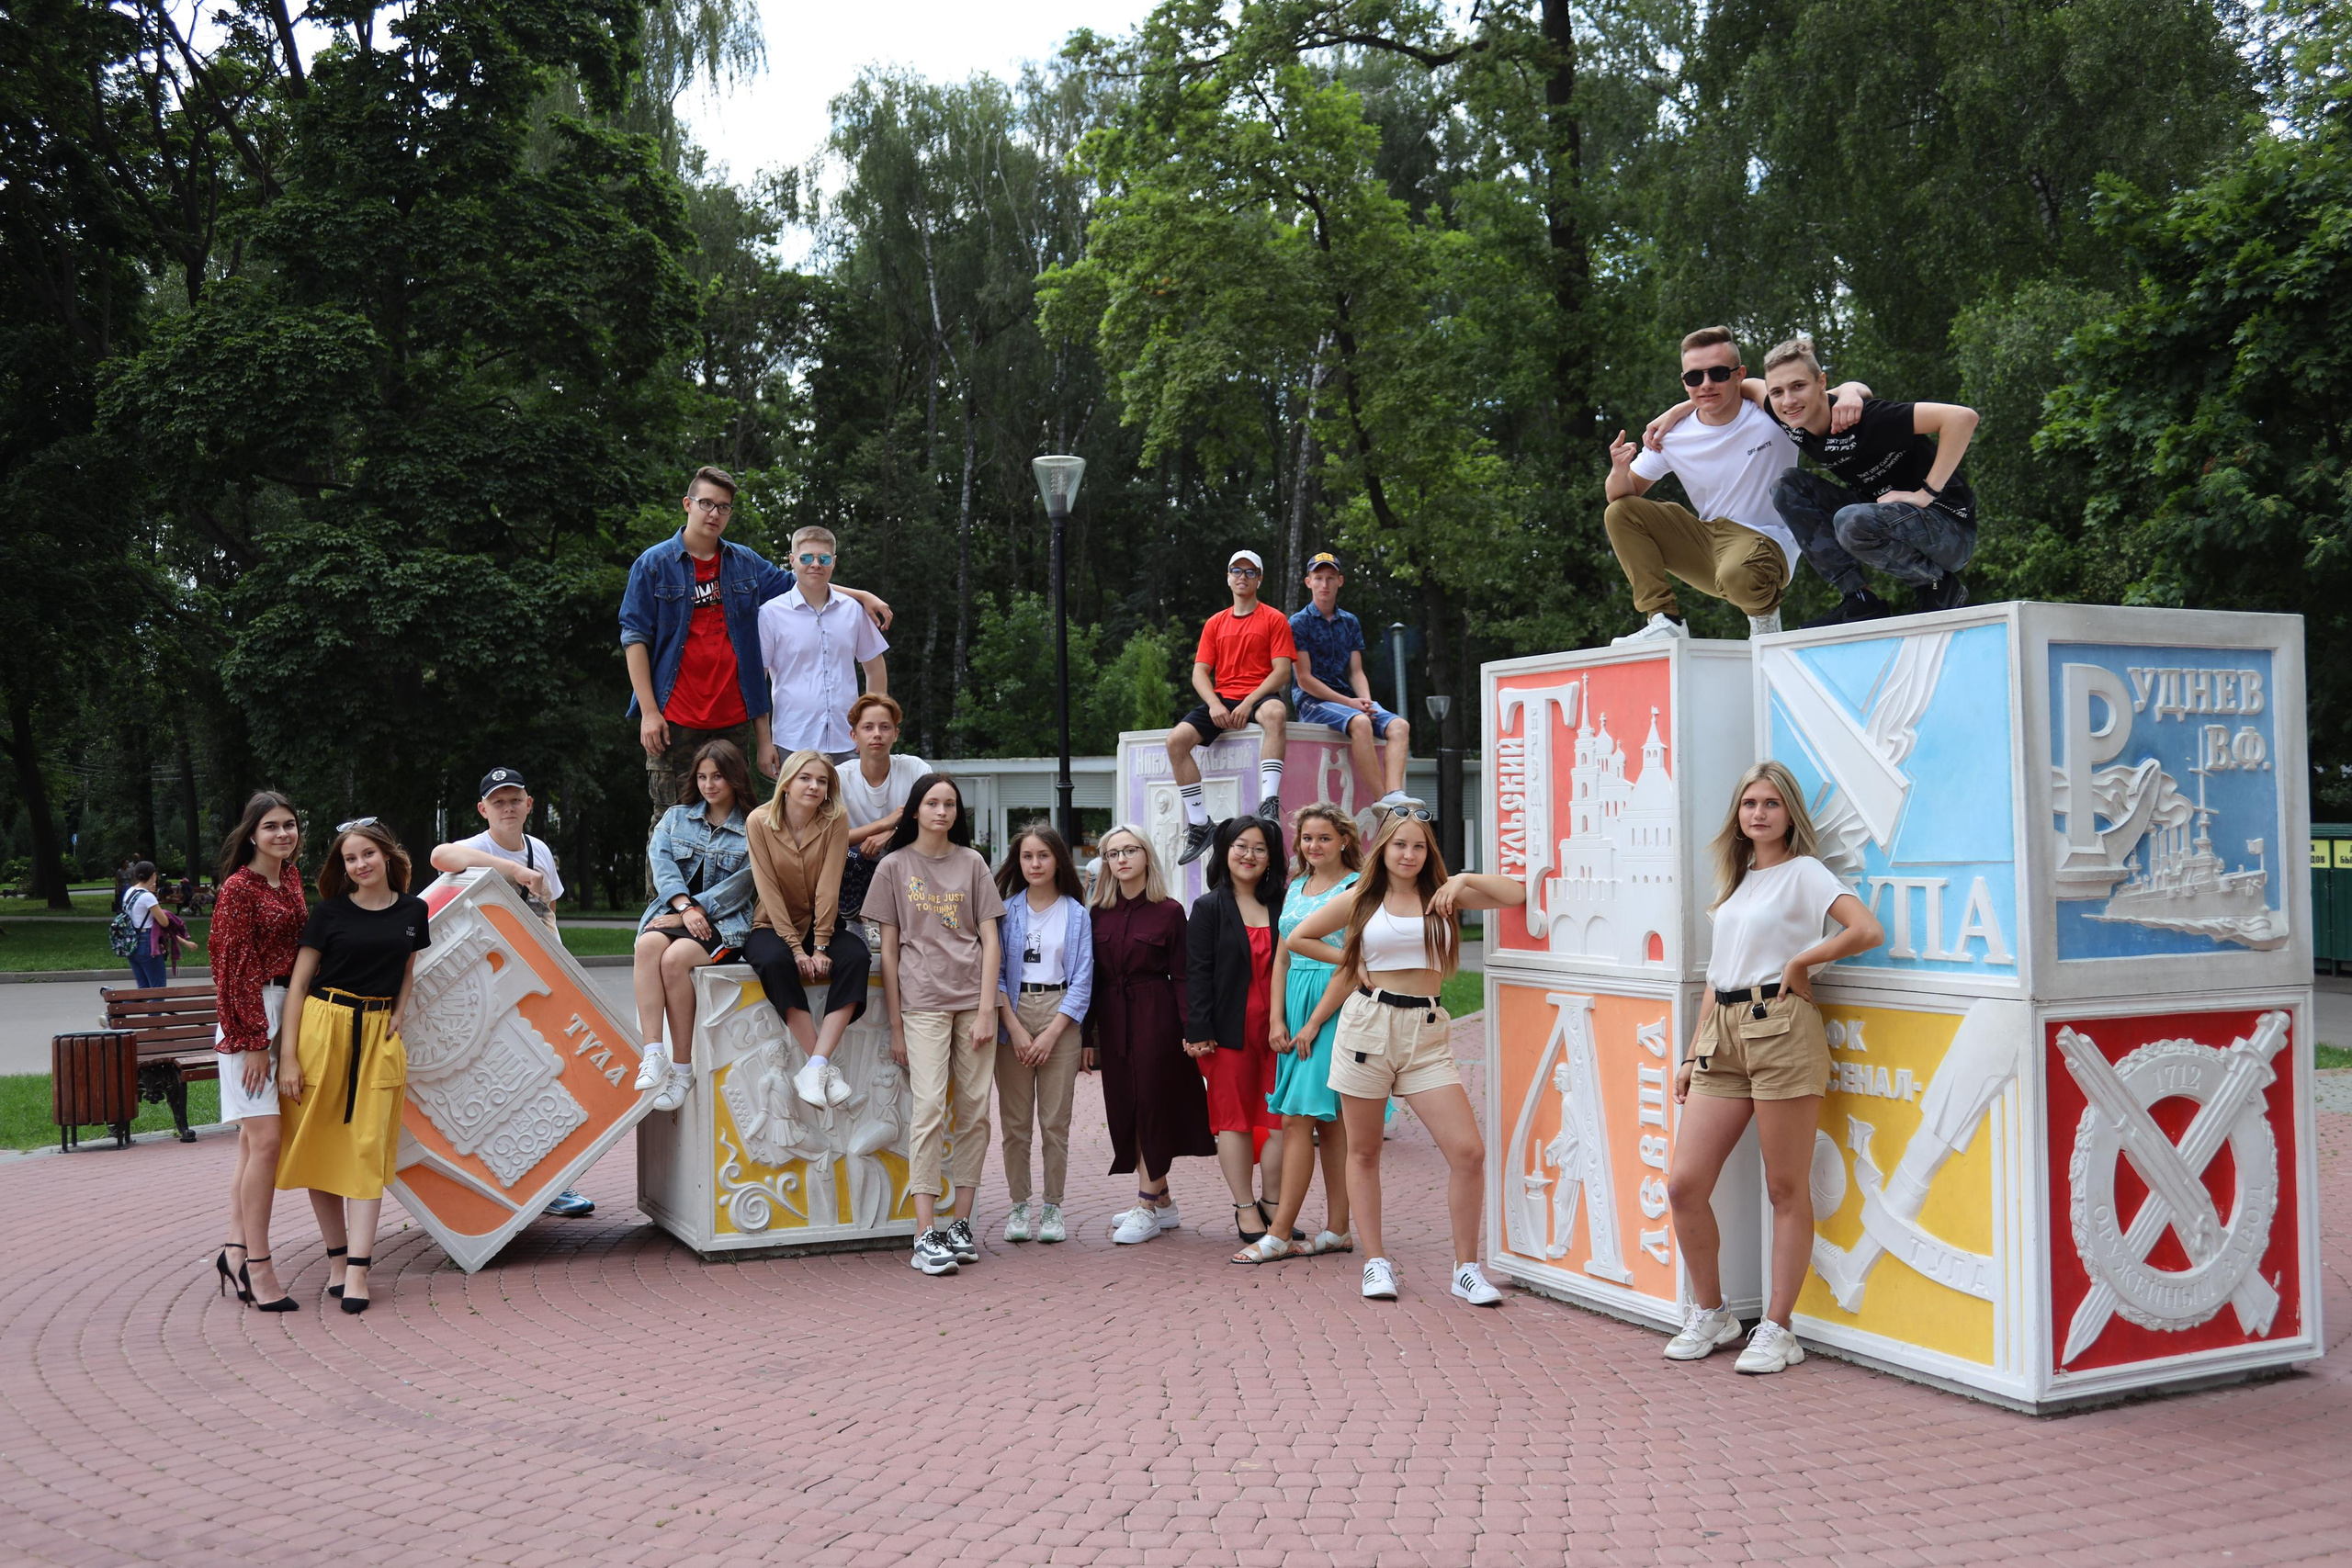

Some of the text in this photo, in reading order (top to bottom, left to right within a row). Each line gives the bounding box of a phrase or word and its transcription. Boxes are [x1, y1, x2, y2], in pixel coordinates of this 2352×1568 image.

[1747, 440, 1772, 456] OFF-WHITE
[908, 892, 965, 904] YOU ARE JUST
[933, 904, 958, 914] FUNNY
[2153, 1062, 2201, 1093] 1712
[1910, 1235, 1990, 1296] ТУЛА
